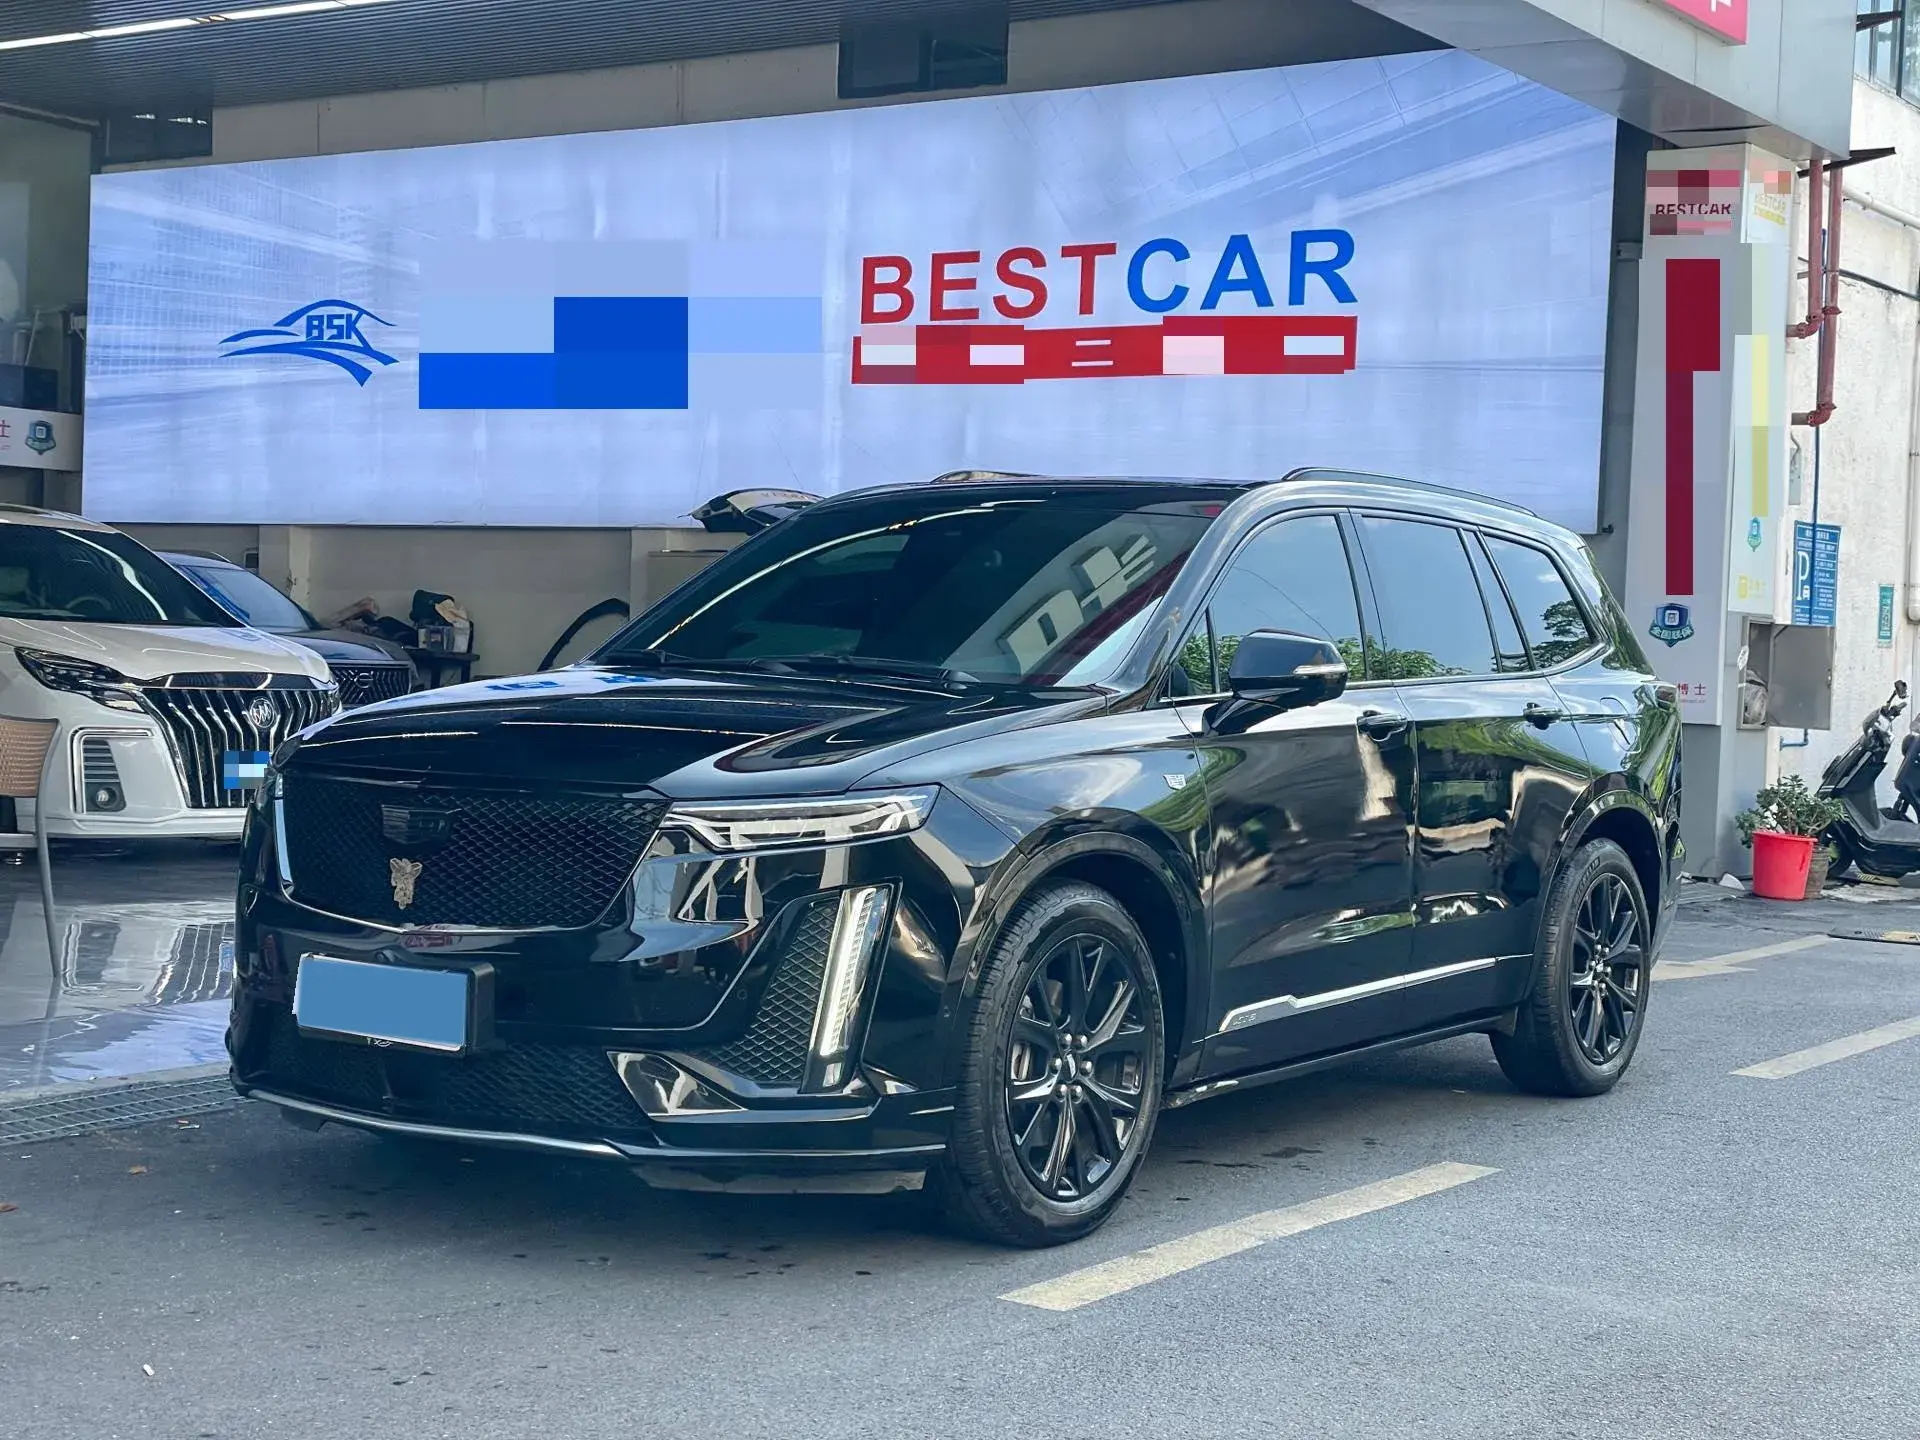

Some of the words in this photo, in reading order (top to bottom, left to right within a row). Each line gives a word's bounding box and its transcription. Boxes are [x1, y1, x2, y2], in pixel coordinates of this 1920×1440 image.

[1655, 203, 1731, 215] BESTCAR
[861, 228, 1359, 325] BESTCAR
[306, 310, 370, 349] BSK
